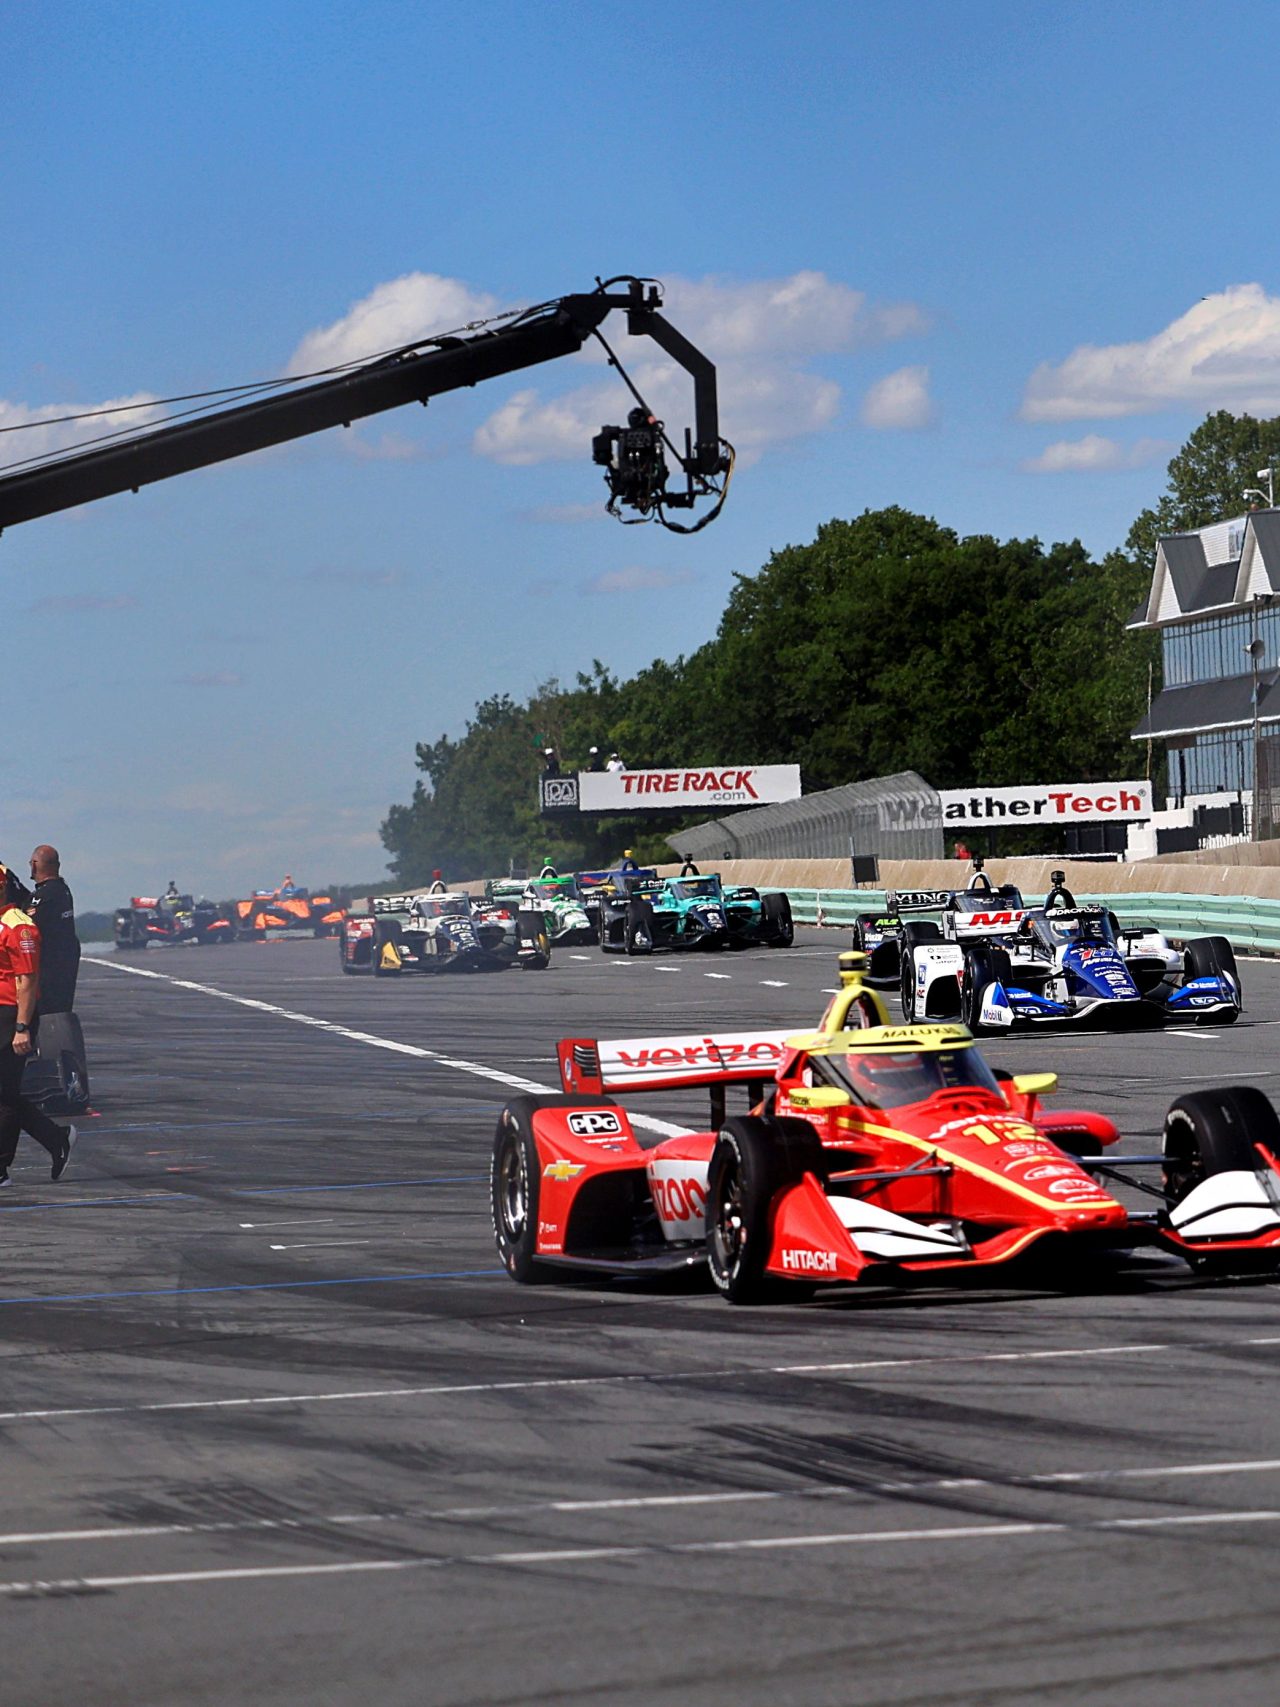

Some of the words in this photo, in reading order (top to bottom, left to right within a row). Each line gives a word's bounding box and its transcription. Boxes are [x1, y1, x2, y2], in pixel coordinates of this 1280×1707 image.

[620, 774, 679, 794] TIRE
[682, 770, 759, 799] RACK
[709, 791, 746, 801] .com
[616, 1037, 785, 1068] verizo
[571, 1114, 619, 1134] PPG
[962, 1121, 1050, 1146] 12
[782, 1249, 838, 1272] HITACHI
